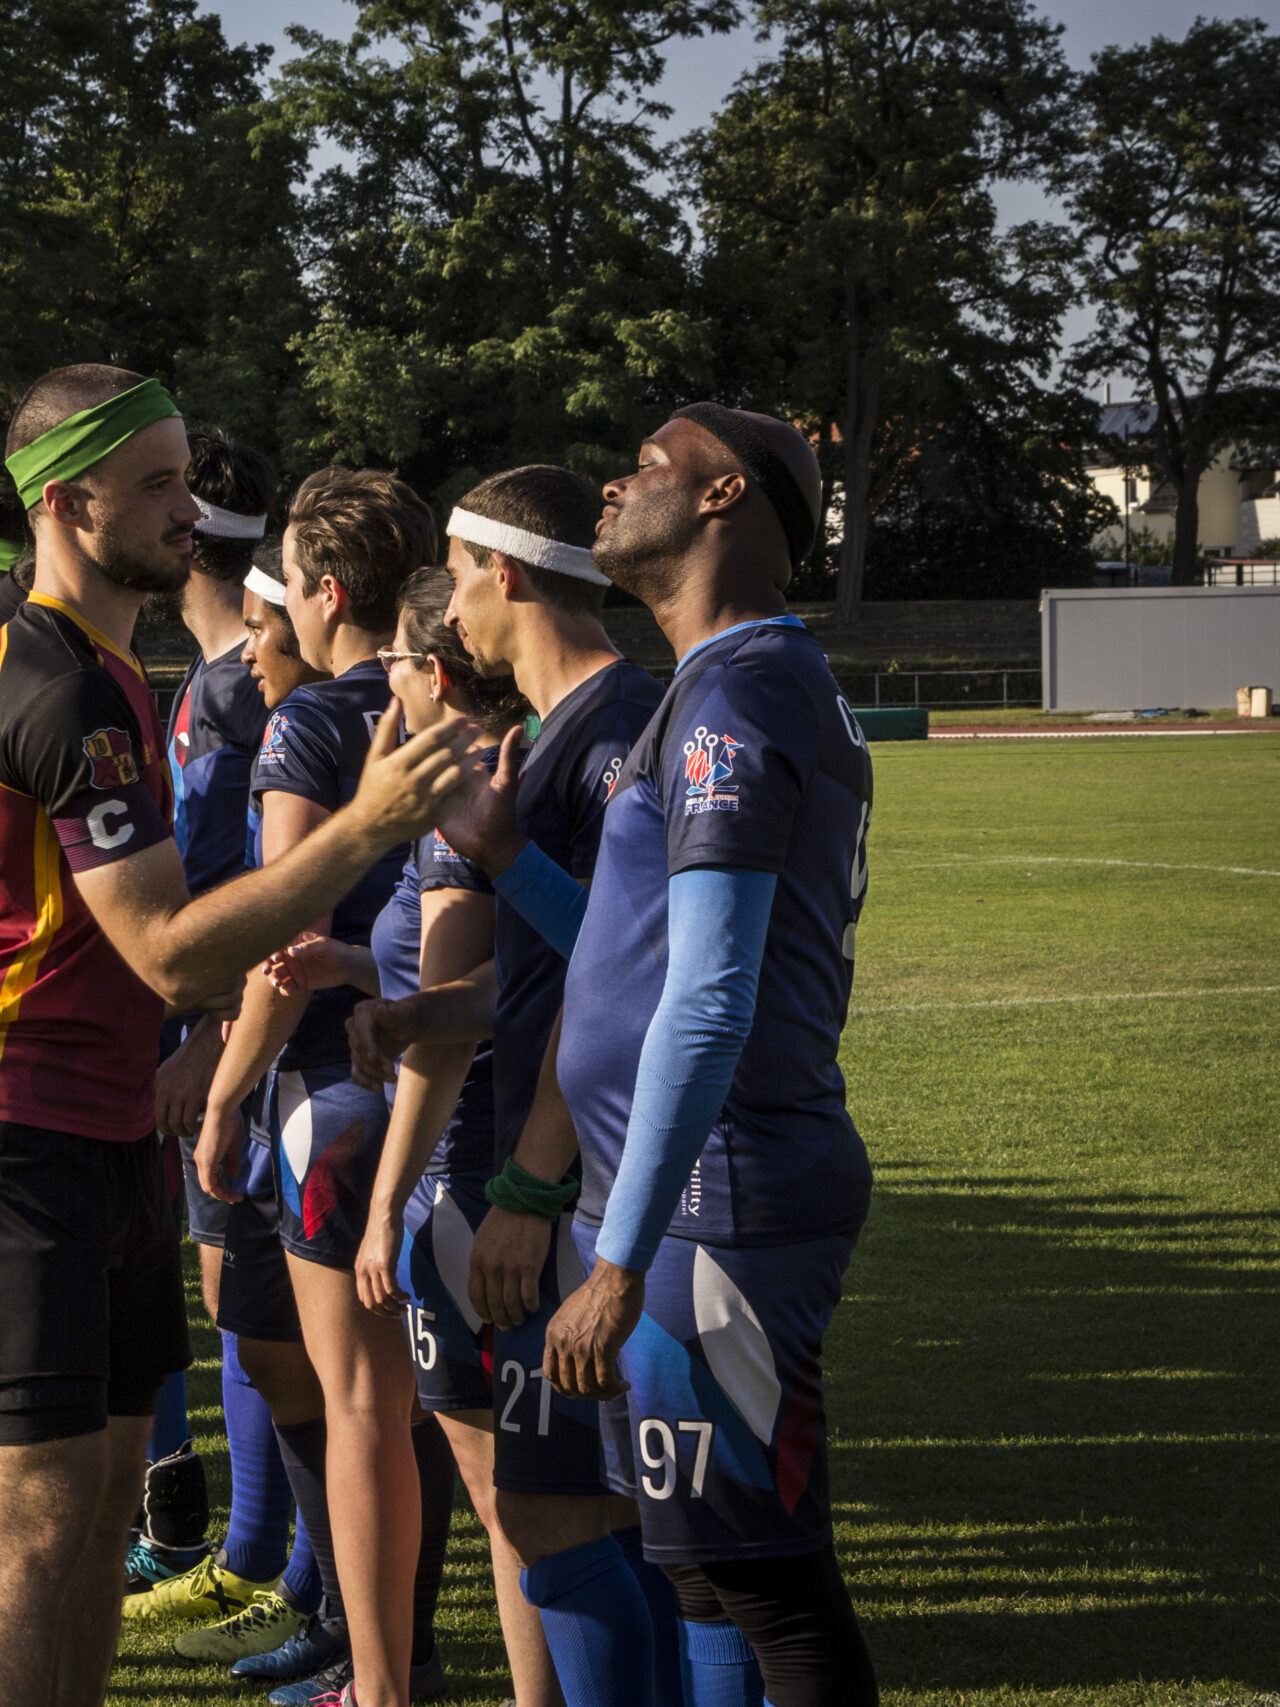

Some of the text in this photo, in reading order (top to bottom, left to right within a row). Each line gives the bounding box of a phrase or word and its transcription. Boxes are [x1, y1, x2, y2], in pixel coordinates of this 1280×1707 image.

[86, 798, 136, 850] C
[684, 799, 739, 816] FRANCE
[406, 1303, 438, 1371] 15
[499, 1359, 552, 1437] 21
[638, 1417, 714, 1500] 97
